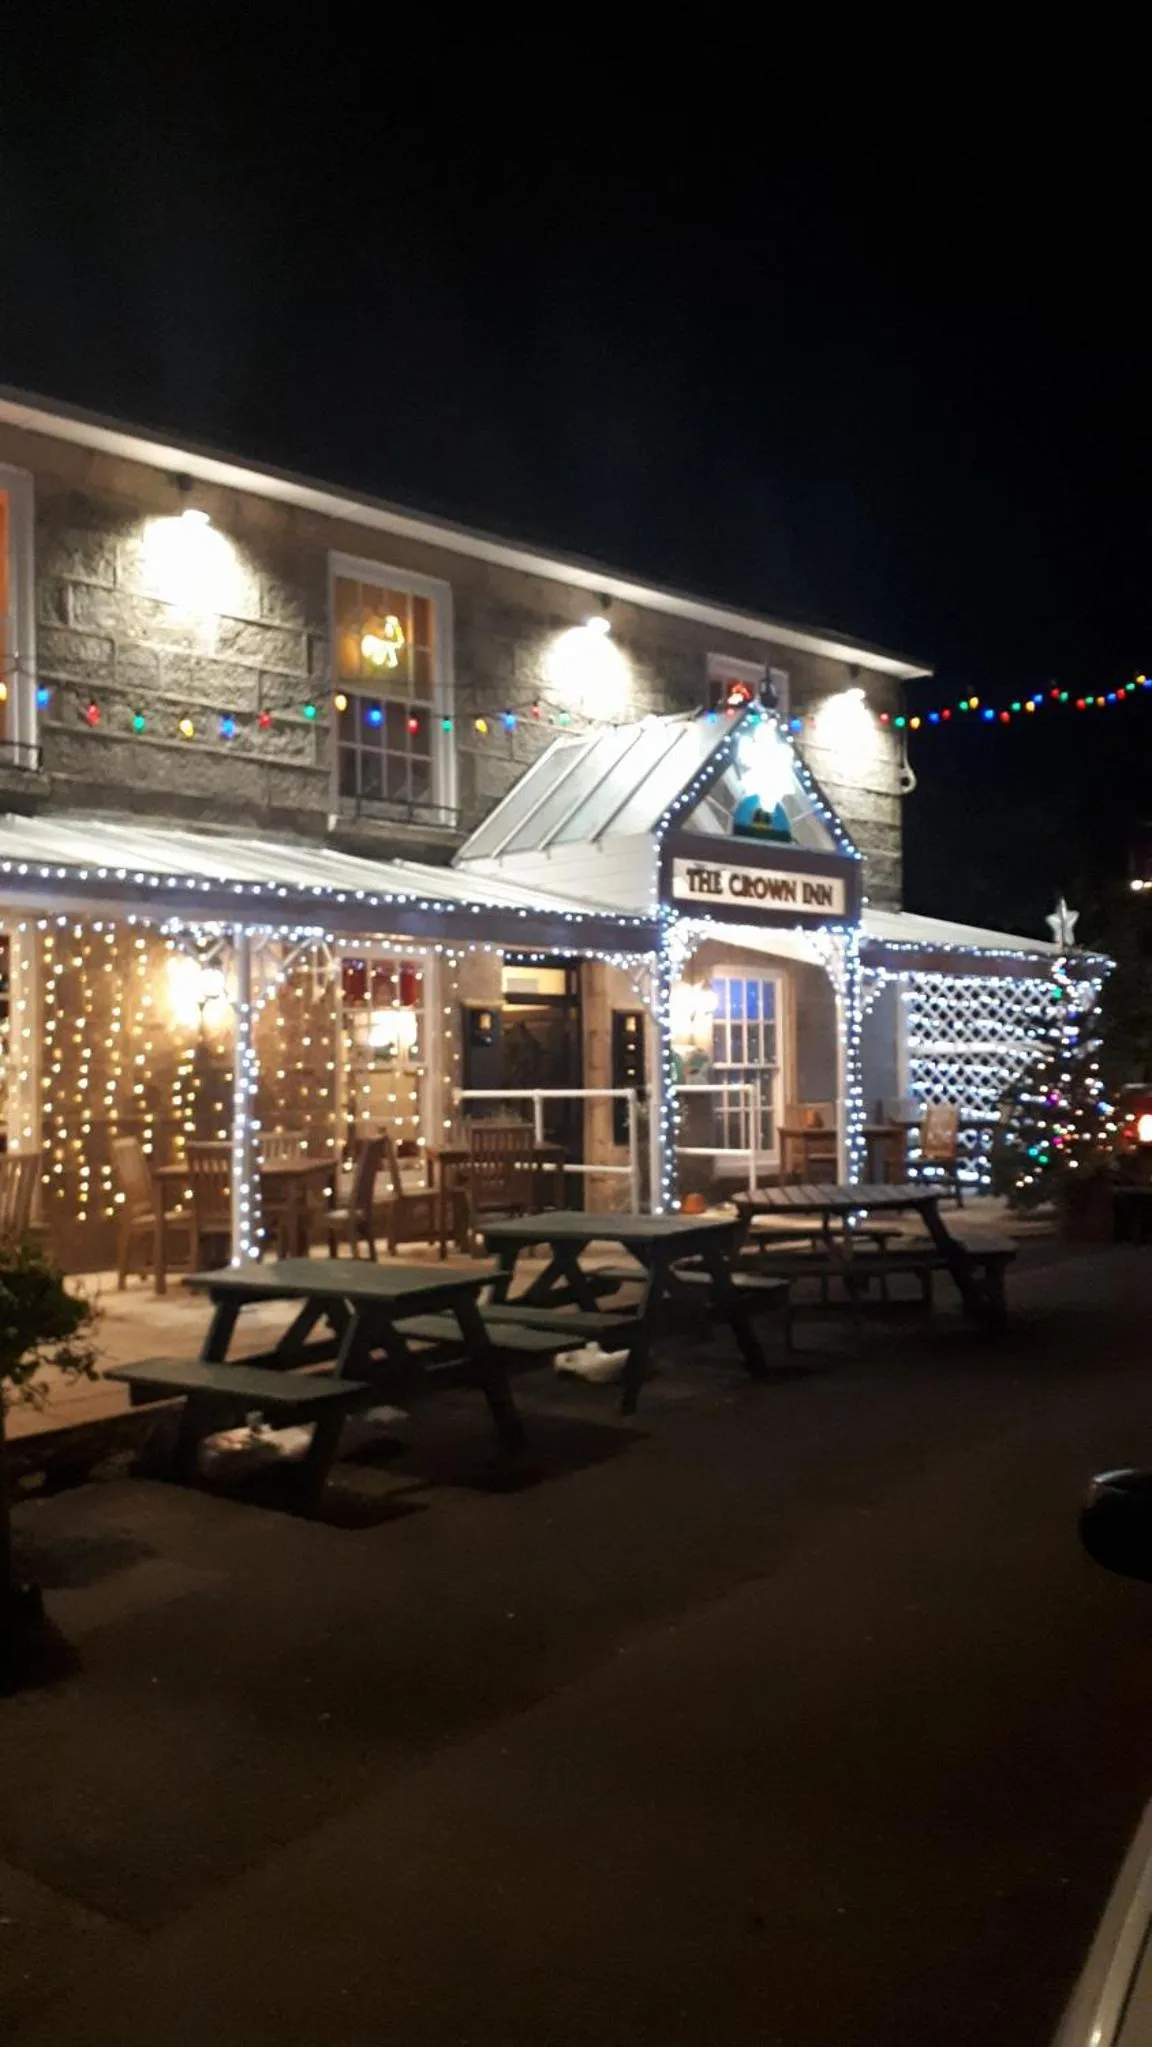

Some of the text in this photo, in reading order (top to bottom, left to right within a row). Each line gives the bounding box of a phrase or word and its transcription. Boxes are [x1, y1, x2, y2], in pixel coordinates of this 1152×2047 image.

[686, 868, 833, 906] THE CROWN INN
